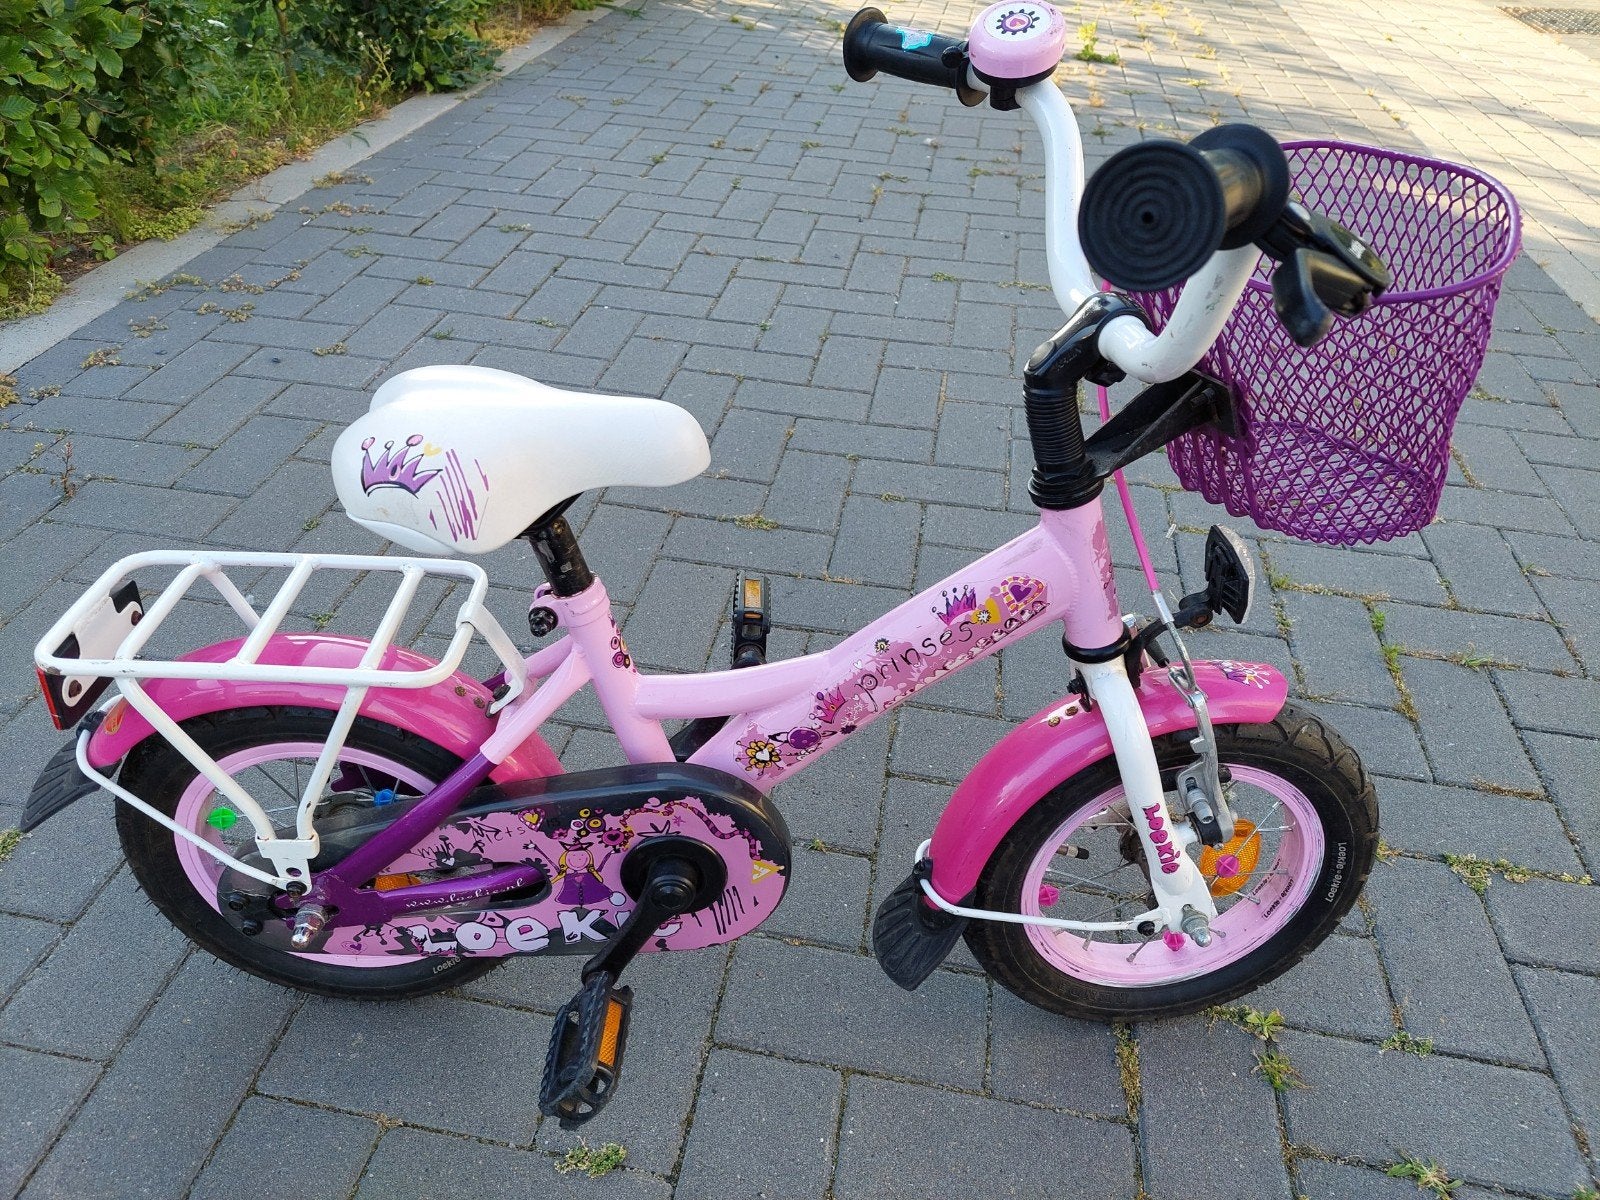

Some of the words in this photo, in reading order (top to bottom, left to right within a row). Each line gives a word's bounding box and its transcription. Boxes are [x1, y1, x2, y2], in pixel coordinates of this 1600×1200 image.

[855, 620, 978, 713] prinses
[1336, 842, 1347, 870] Loekie
[432, 956, 461, 974] Loekie
